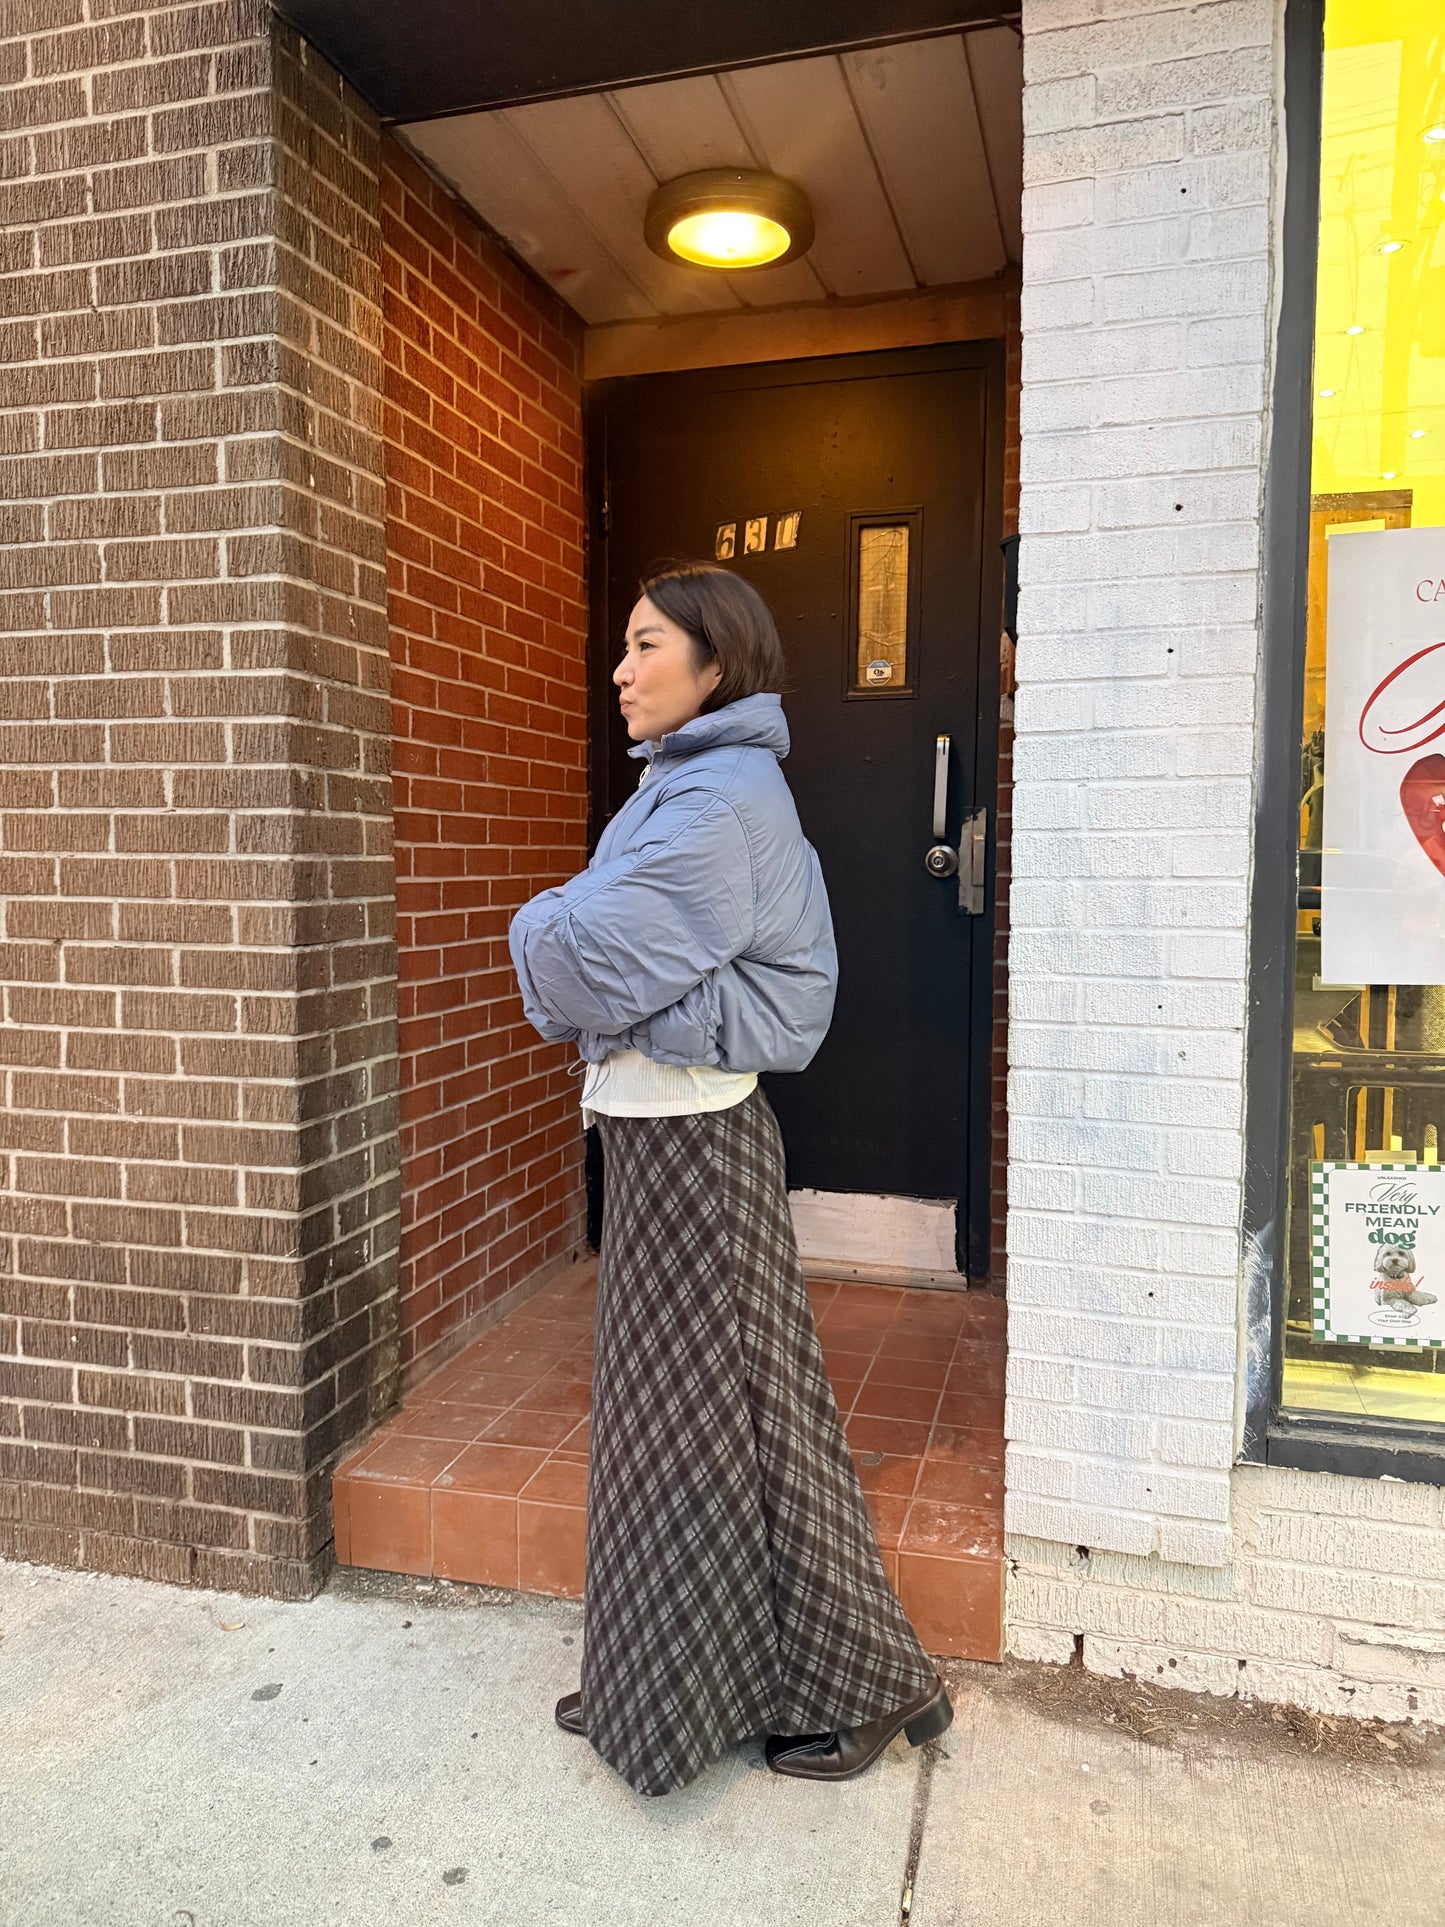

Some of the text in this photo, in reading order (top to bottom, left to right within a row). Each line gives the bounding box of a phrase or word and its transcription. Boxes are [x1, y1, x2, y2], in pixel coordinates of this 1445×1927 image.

[1369, 1182, 1418, 1207] Very
[1344, 1202, 1441, 1216] FRIENDLY
[1365, 1216, 1419, 1228] MEAN
[1367, 1227, 1417, 1250] dog
